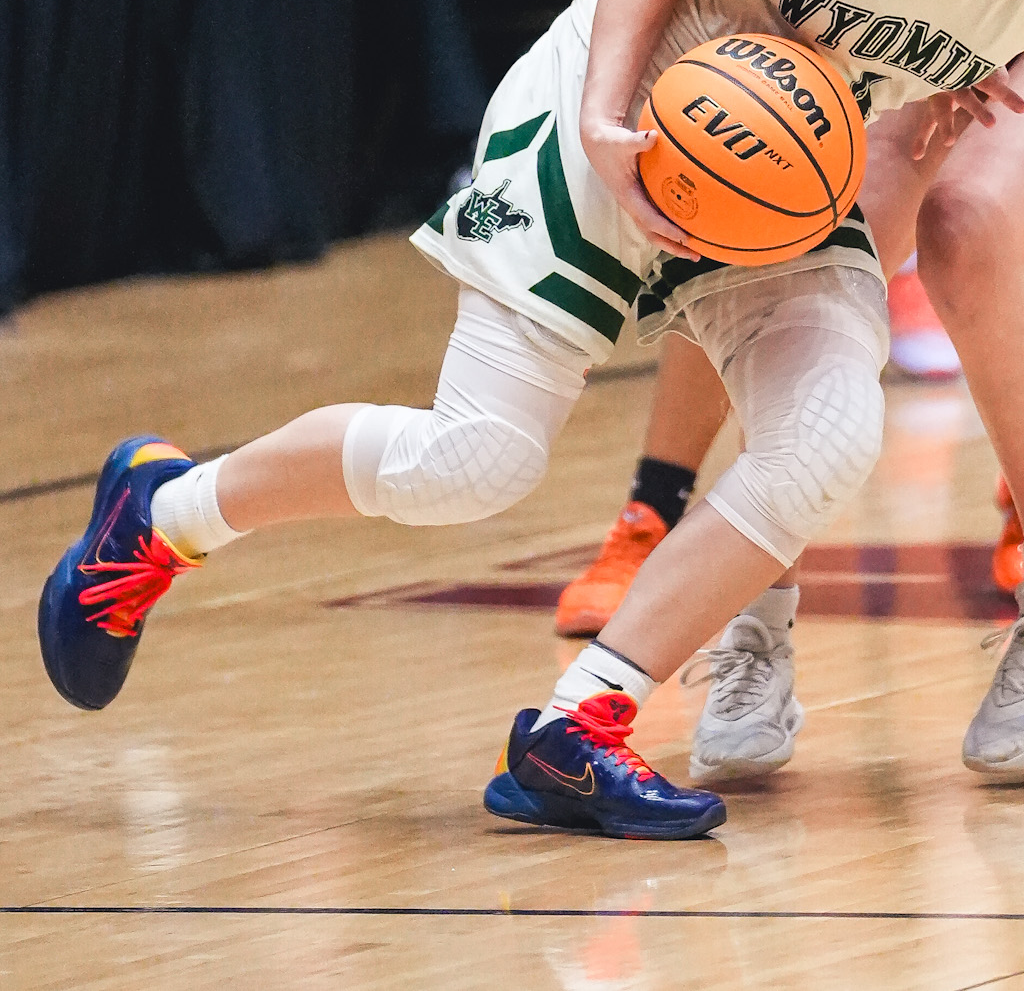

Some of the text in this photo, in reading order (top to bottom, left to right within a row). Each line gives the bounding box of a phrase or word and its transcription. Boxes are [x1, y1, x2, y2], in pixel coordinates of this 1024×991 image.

[681, 94, 794, 171] EVO NXT
[715, 38, 832, 141] Wilson
